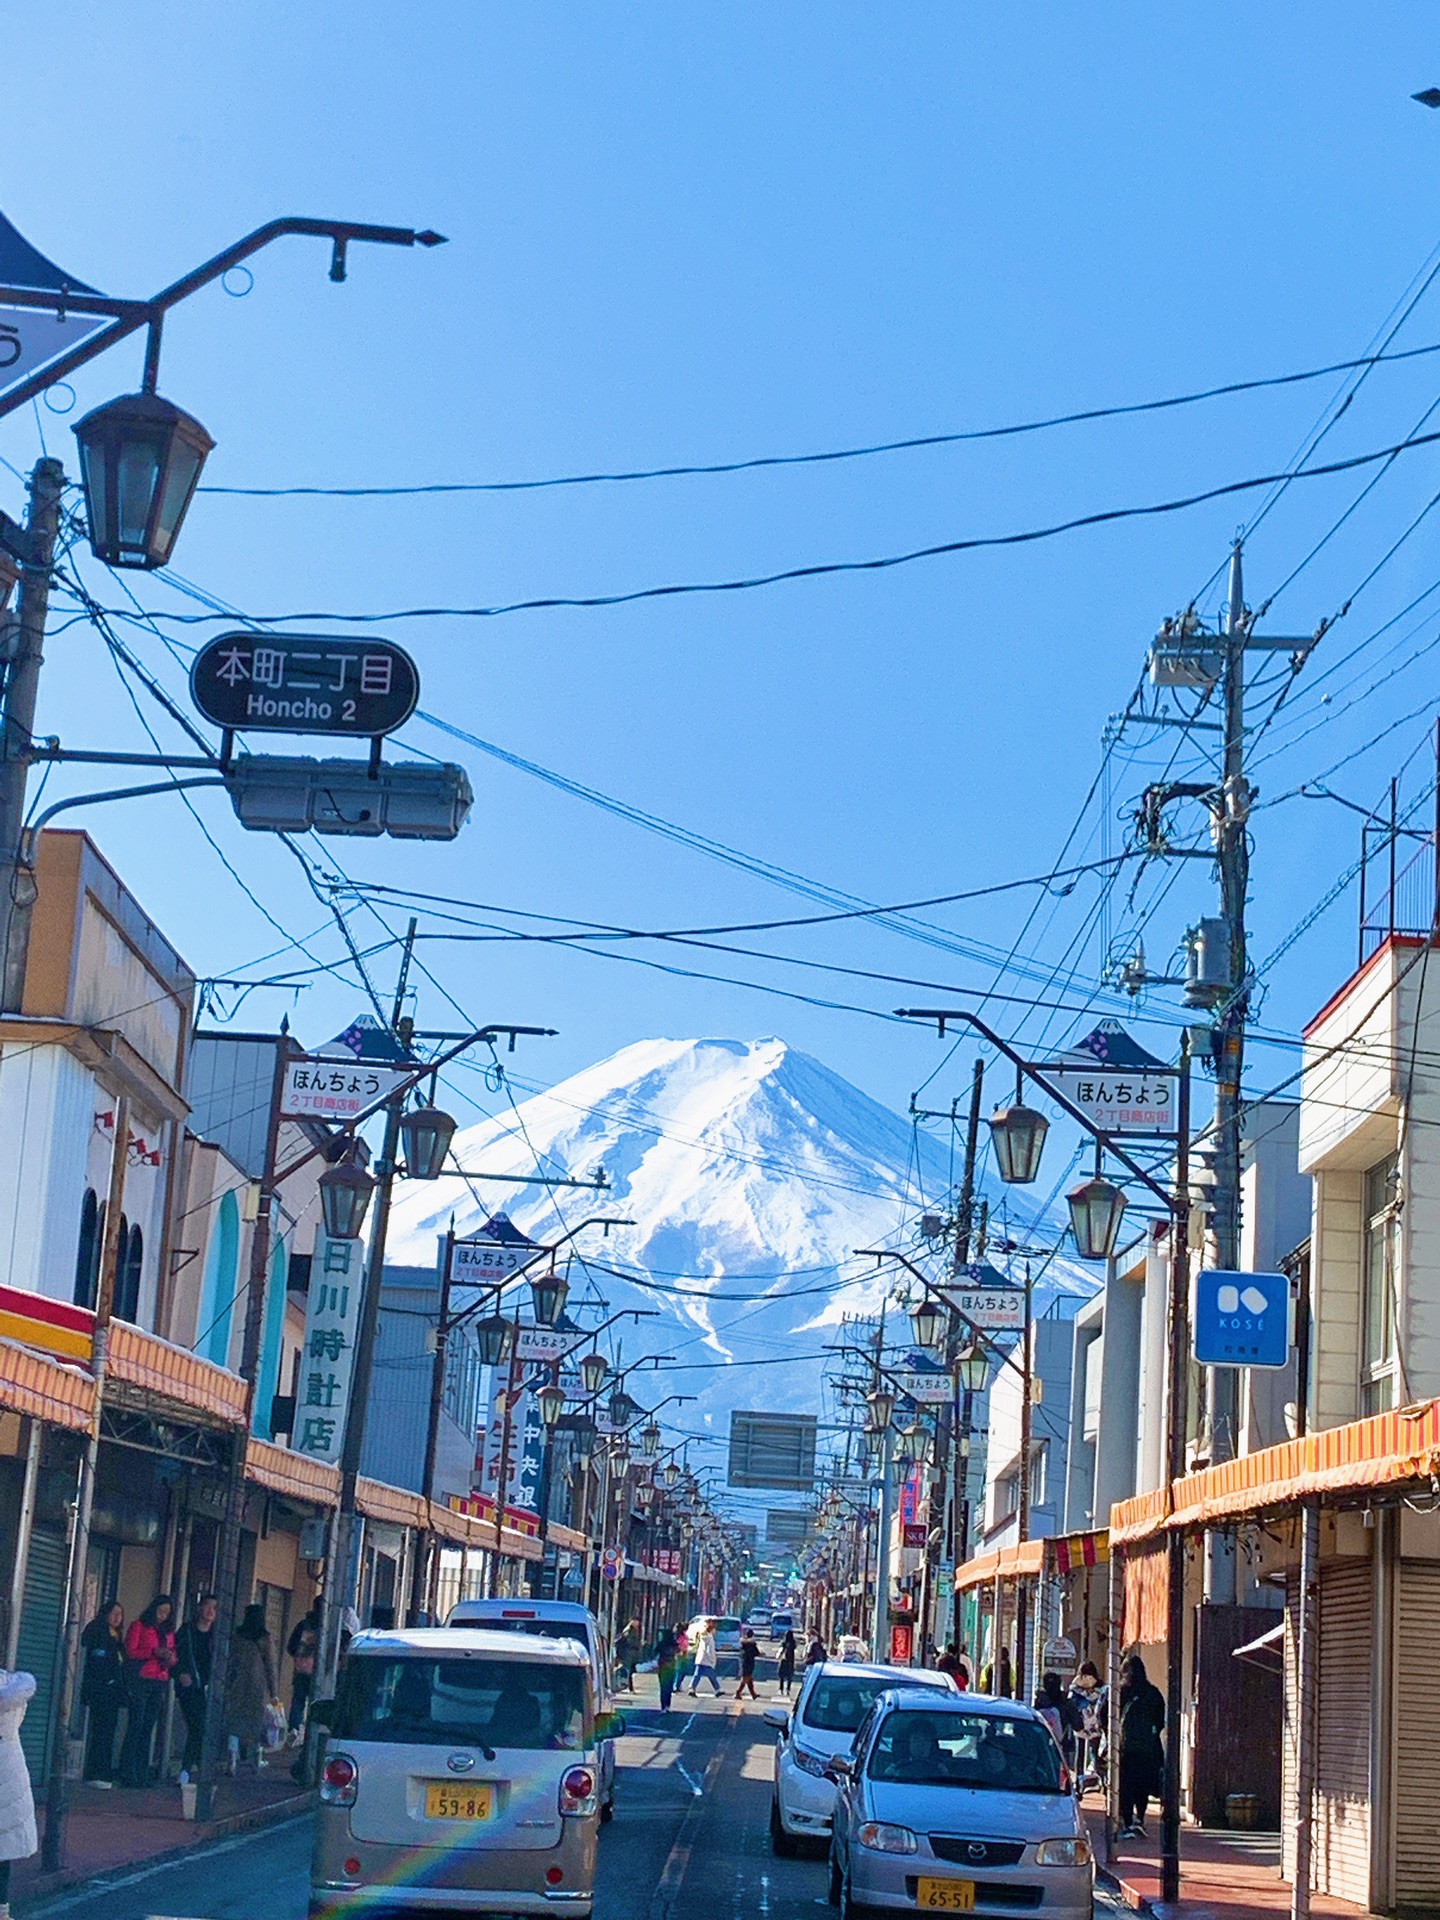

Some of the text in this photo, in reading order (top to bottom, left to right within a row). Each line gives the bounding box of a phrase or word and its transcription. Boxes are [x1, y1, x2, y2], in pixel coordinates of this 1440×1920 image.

[216, 646, 392, 694] 本町二丁目
[246, 694, 357, 721] Honcho 2
[293, 1069, 379, 1095] ほんちょう
[1077, 1082, 1169, 1105] ほんちょう
[458, 1250, 518, 1268] ほんちょう
[961, 1296, 1019, 1311] ほんちょう
[299, 1240, 352, 1452] 日川時計店
[521, 1334, 568, 1349] ほんちょう
[907, 1378, 951, 1389] ほんちょう
[439, 1800, 486, 1818] 59-86
[929, 1890, 969, 1909] 65-51
